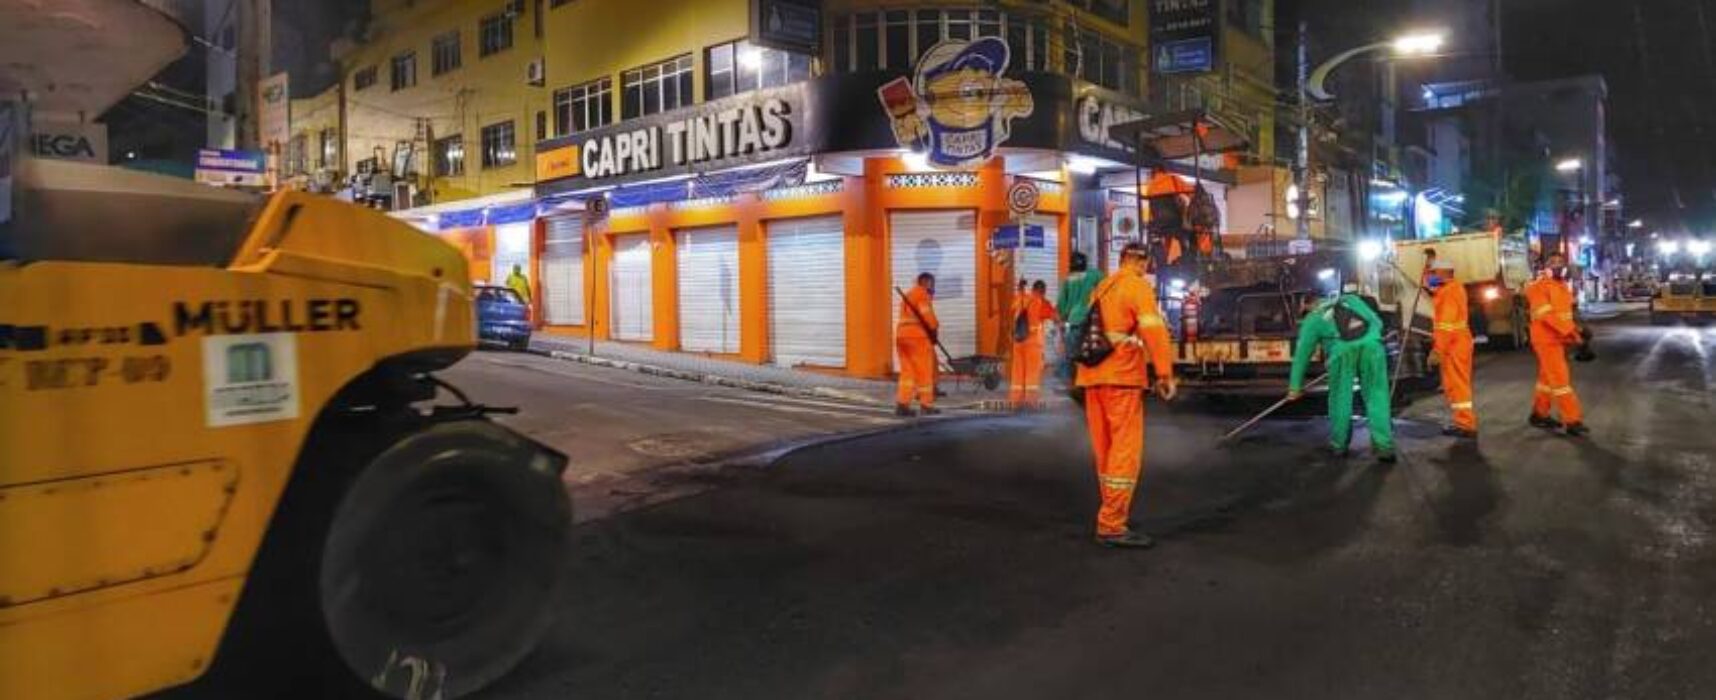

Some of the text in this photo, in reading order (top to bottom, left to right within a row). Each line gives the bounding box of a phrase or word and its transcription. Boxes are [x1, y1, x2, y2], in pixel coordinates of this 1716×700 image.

[582, 99, 793, 179] CAPRI TINTAS
[172, 300, 361, 338] MÜLLER
